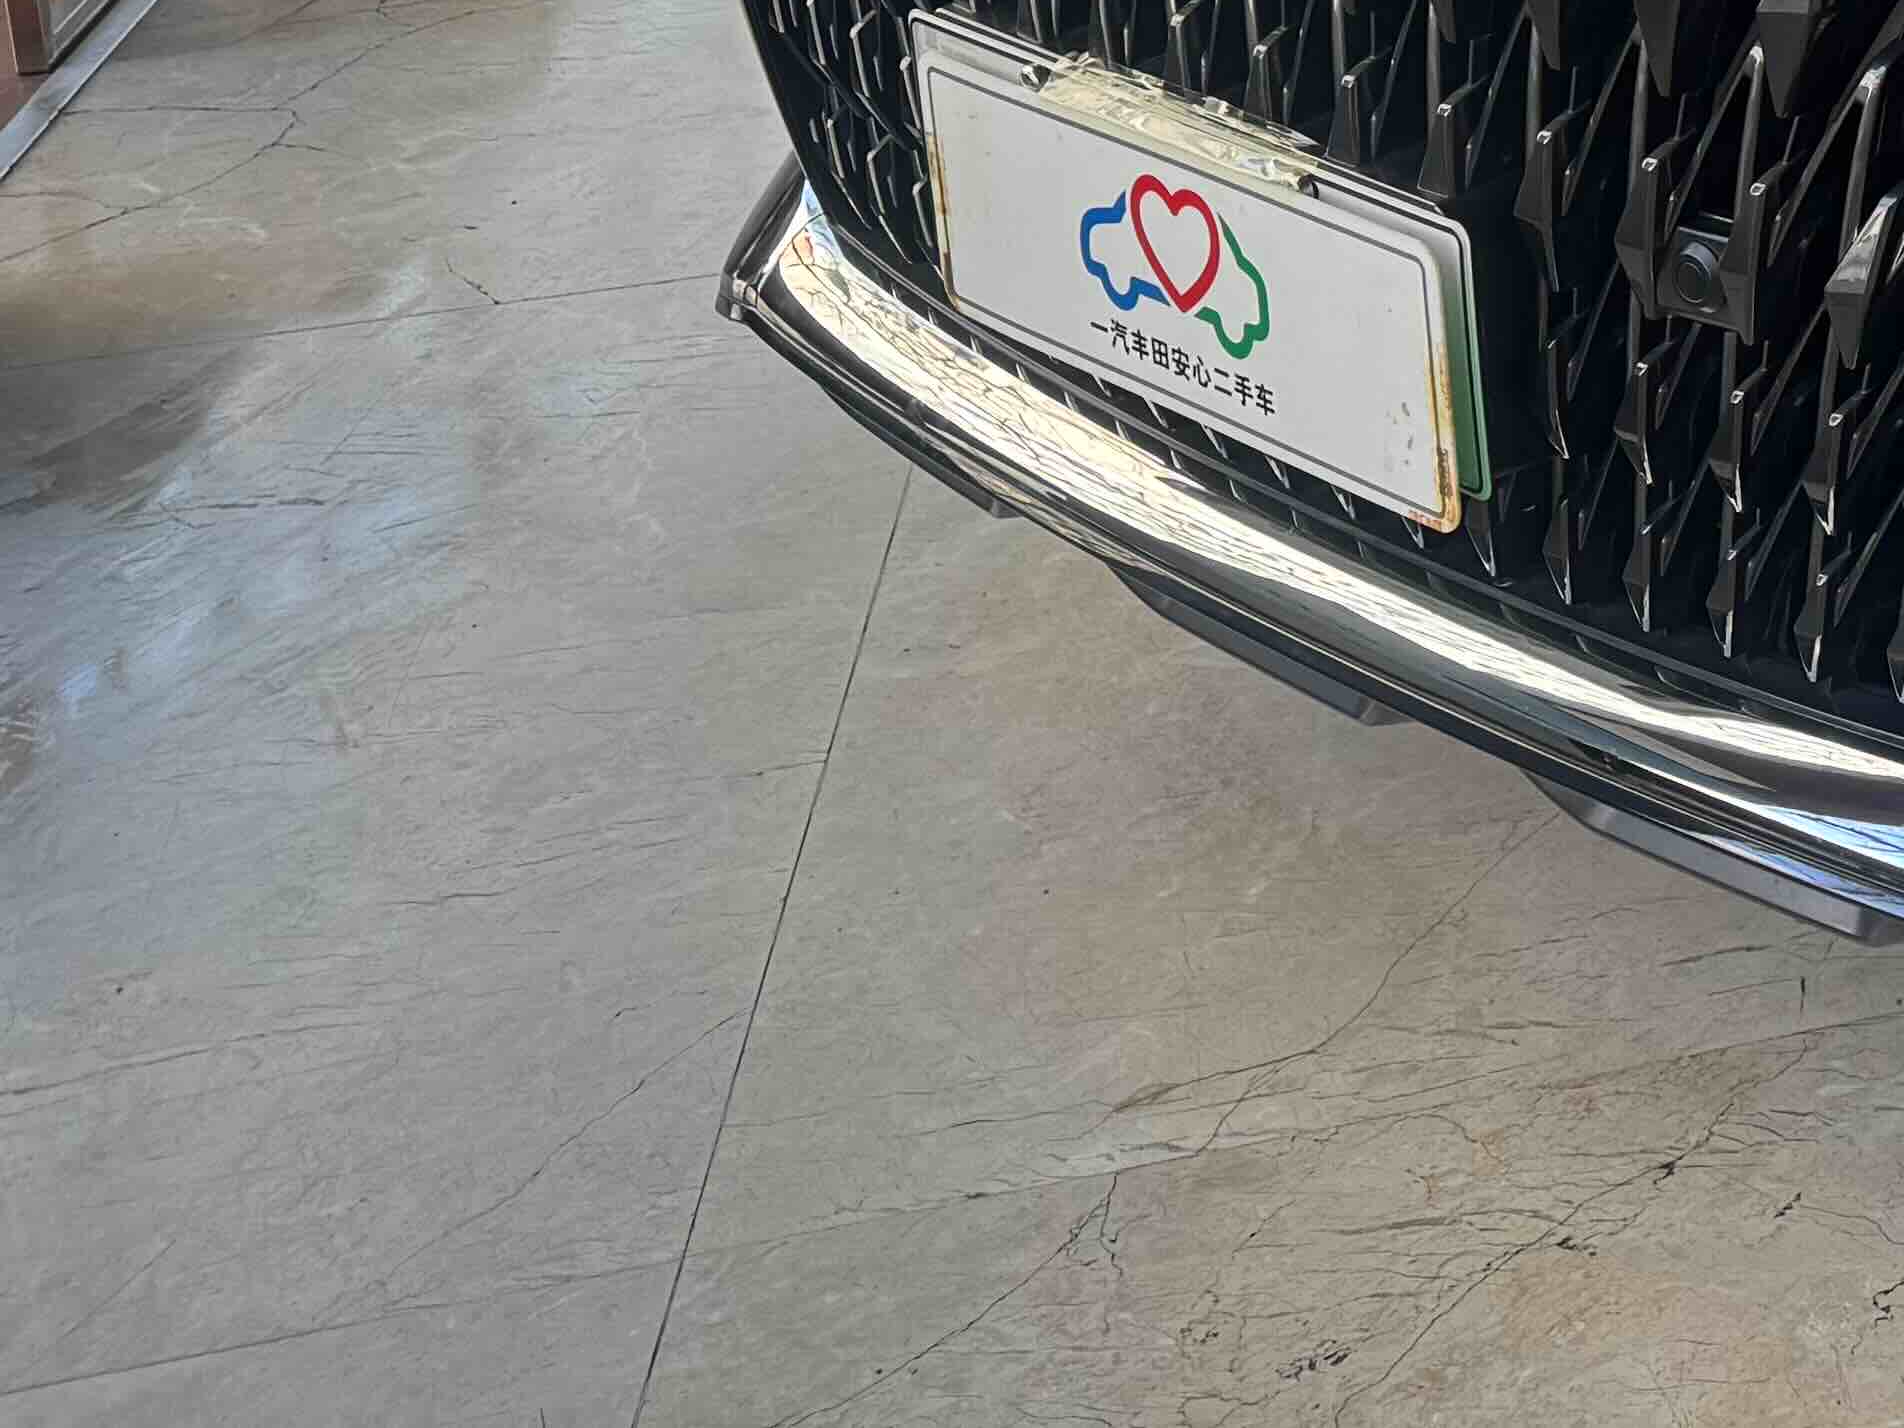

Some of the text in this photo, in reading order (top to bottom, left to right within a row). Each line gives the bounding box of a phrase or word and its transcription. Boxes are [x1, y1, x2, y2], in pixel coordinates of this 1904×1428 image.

[1089, 318, 1277, 417] 一汽丰田安心二手车
